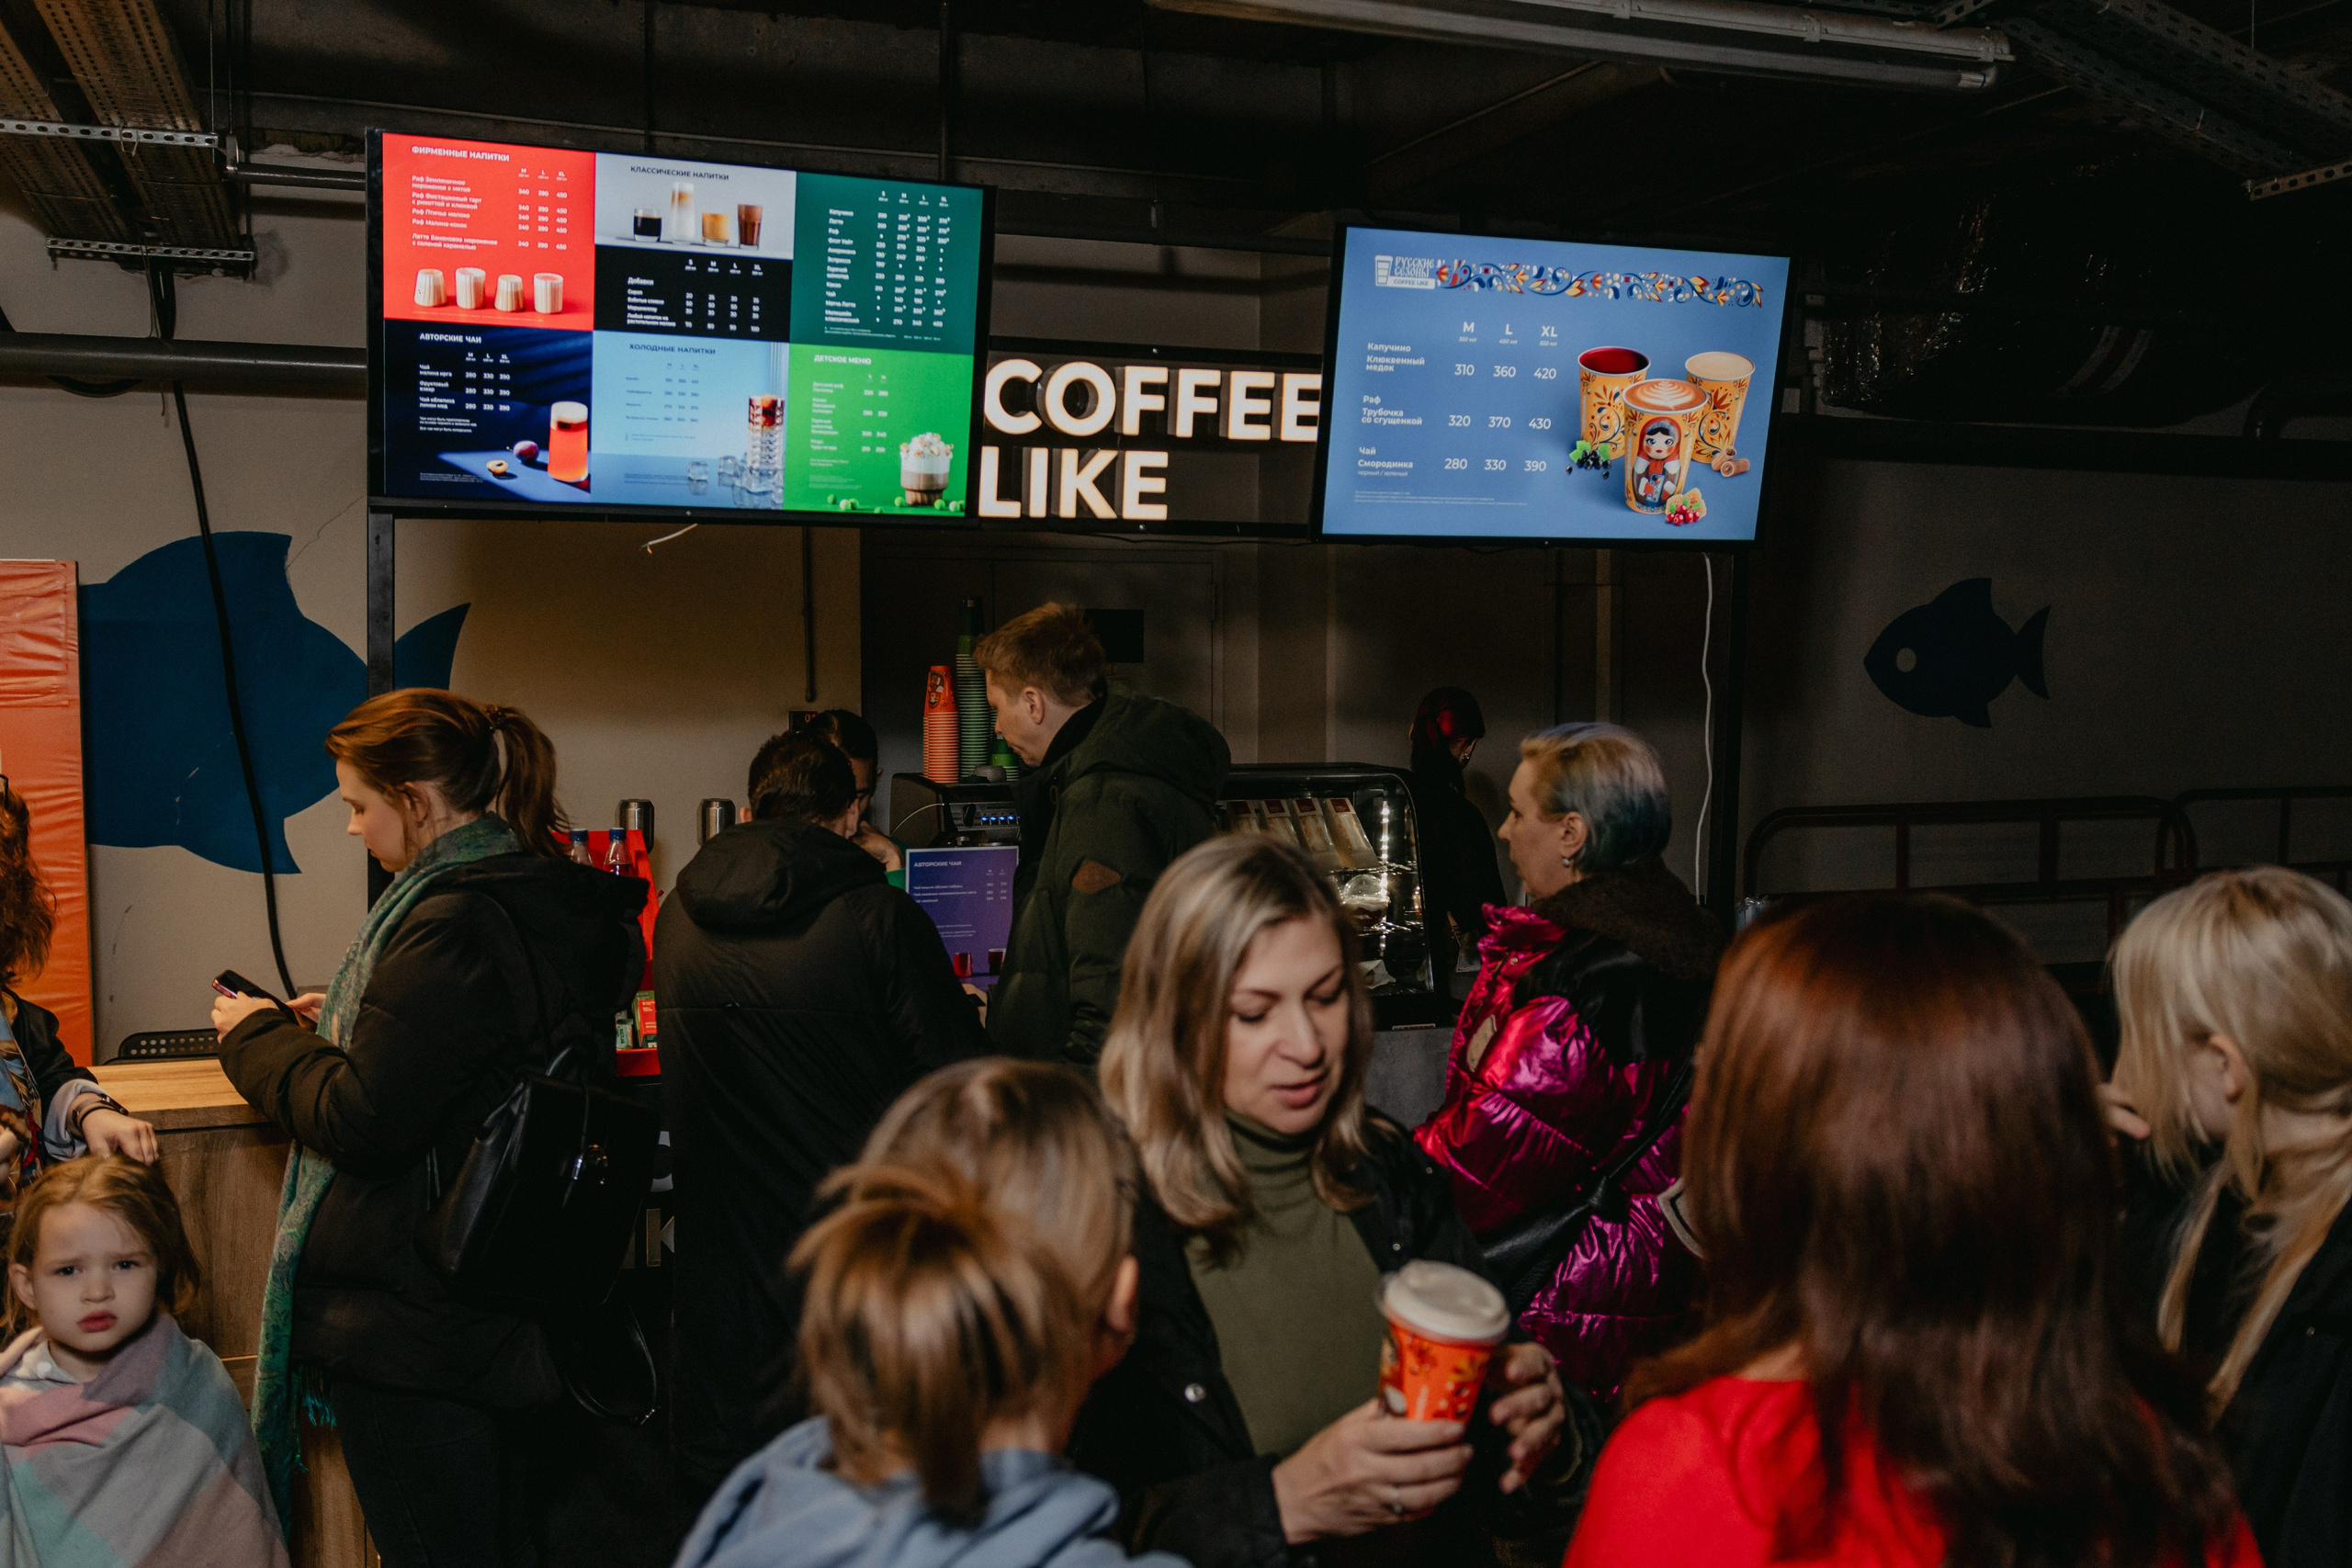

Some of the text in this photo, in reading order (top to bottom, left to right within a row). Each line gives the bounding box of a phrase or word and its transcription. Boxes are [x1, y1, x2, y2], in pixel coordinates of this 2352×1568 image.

[412, 146, 509, 162] ФИРМЕННЫЕ НАПИТКИ
[631, 165, 729, 180] КЛАССИЧЕСКИЕ НАПИТКИ
[1463, 321, 1558, 337] M L XL
[420, 333, 463, 343] АВТОРСКИЕ
[629, 344, 675, 352] ХОЛОДНЫЕ
[1367, 343, 1411, 353] Капучино
[814, 355, 872, 365] ДЕТСКОЕ МЕНЮ
[1367, 355, 1425, 366] Клюквенный
[1366, 364, 1394, 372] медок
[1454, 364, 1556, 379] 310 360 420
[984, 358, 1322, 443] COFFEE
[1363, 395, 1381, 404] Раф
[1363, 408, 1404, 417] Трубочка
[1374, 417, 1422, 425] сгущенкой
[1448, 414, 1551, 430] 320 370 430
[1359, 446, 1376, 455] Чай
[1358, 459, 1413, 468] Смородинка
[1444, 458, 1547, 471] 280 330 390
[978, 446, 1169, 521] LIKE
